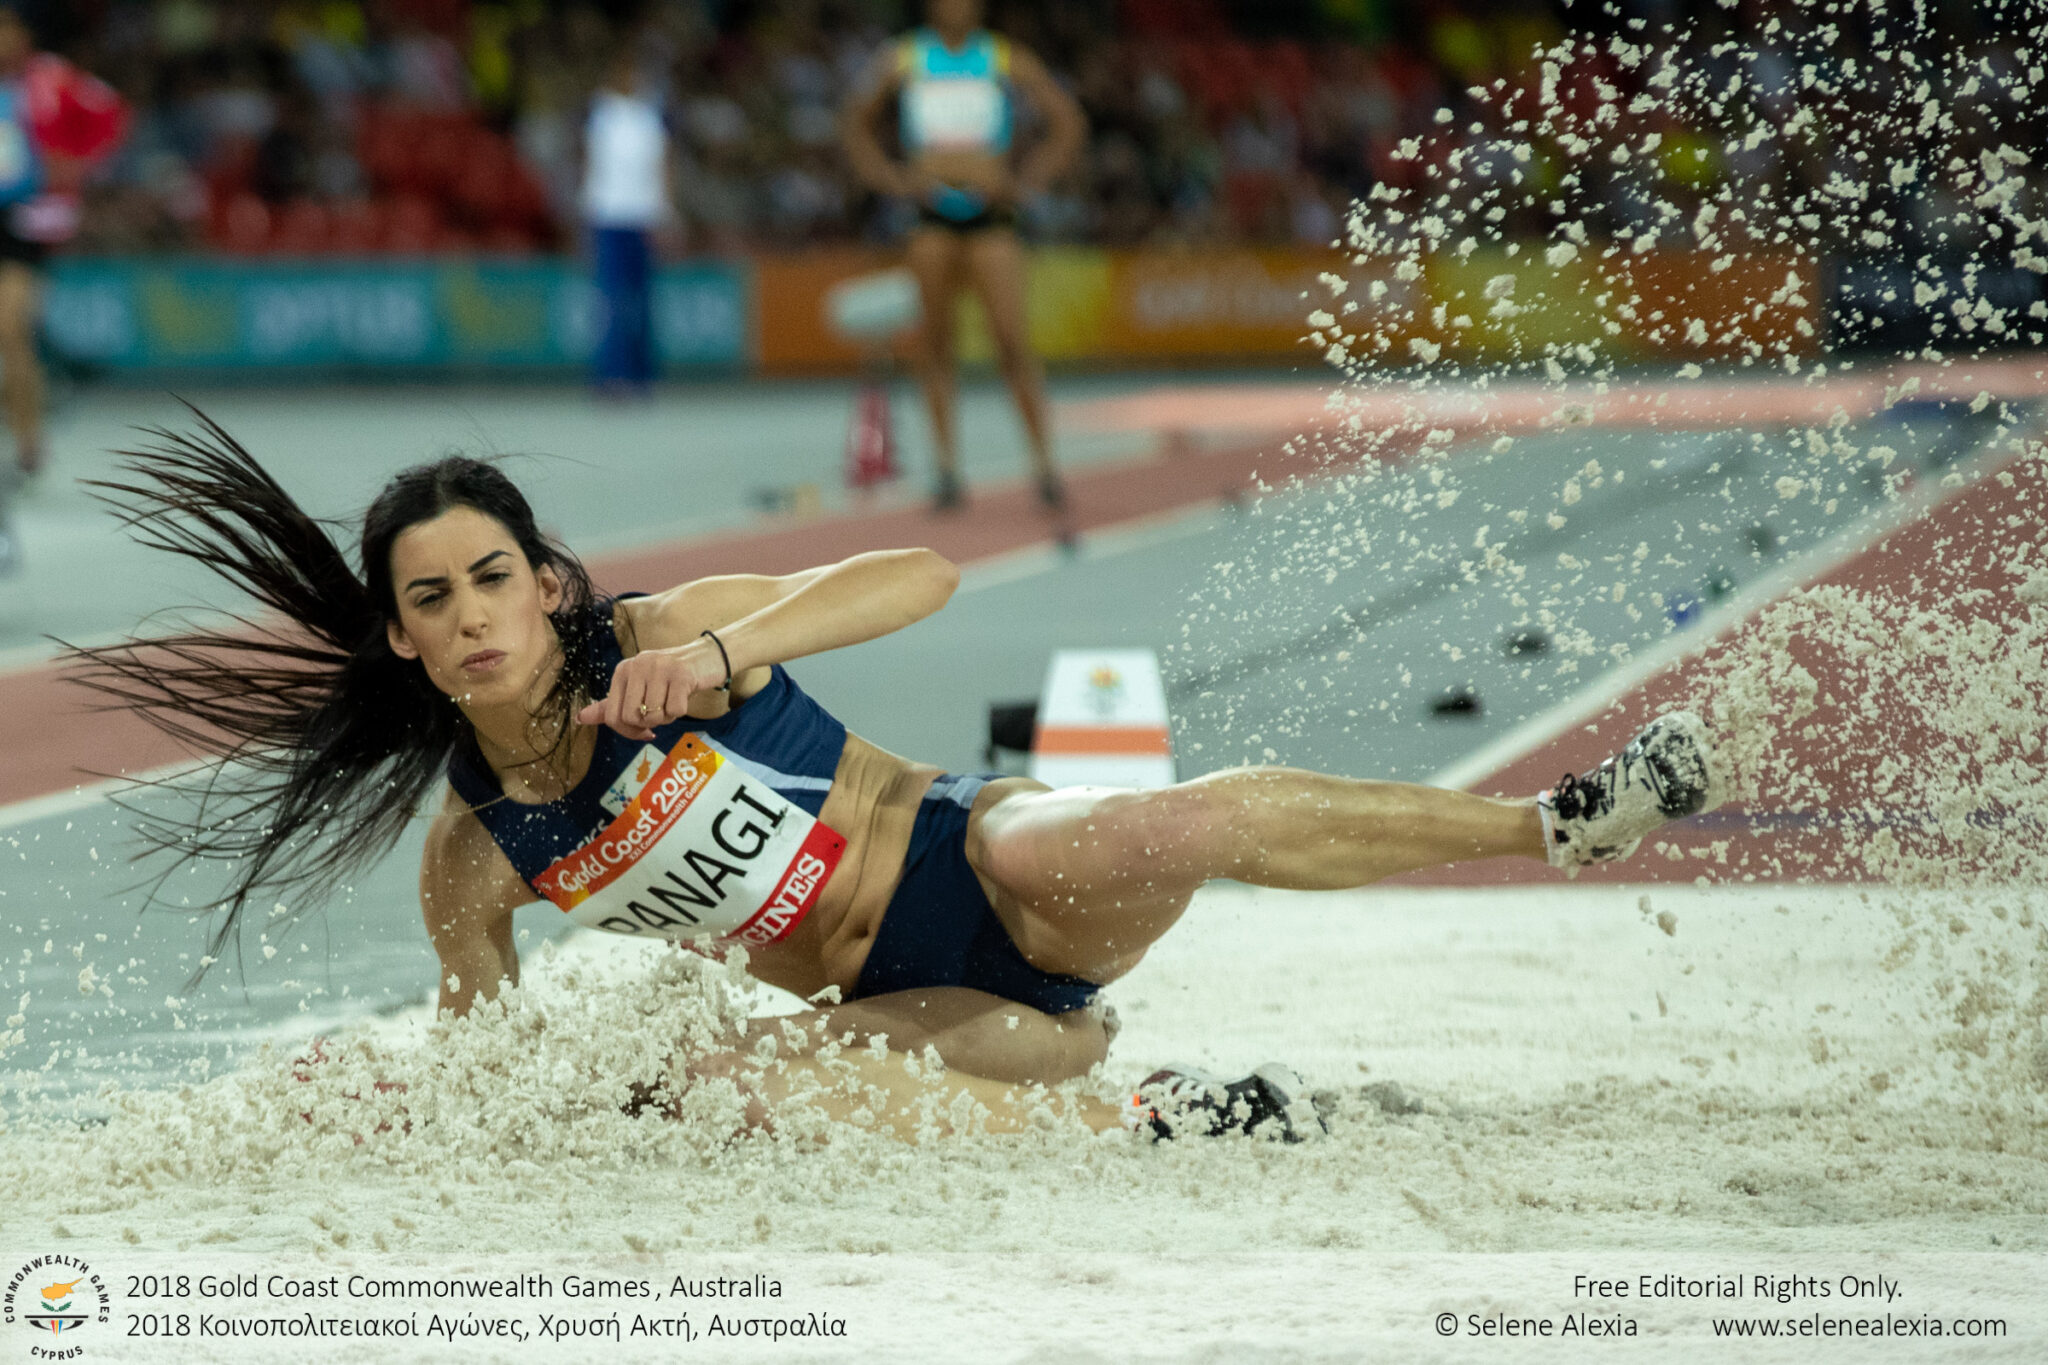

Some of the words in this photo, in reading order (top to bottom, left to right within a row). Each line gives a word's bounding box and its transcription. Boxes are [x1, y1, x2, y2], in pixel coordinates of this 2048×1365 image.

[557, 853, 609, 892] Gold
[600, 807, 659, 864] Coast
[651, 758, 698, 815] 2018
[640, 796, 689, 851] Commonwealth
[685, 771, 709, 800] Games
[735, 851, 827, 946] GINES
